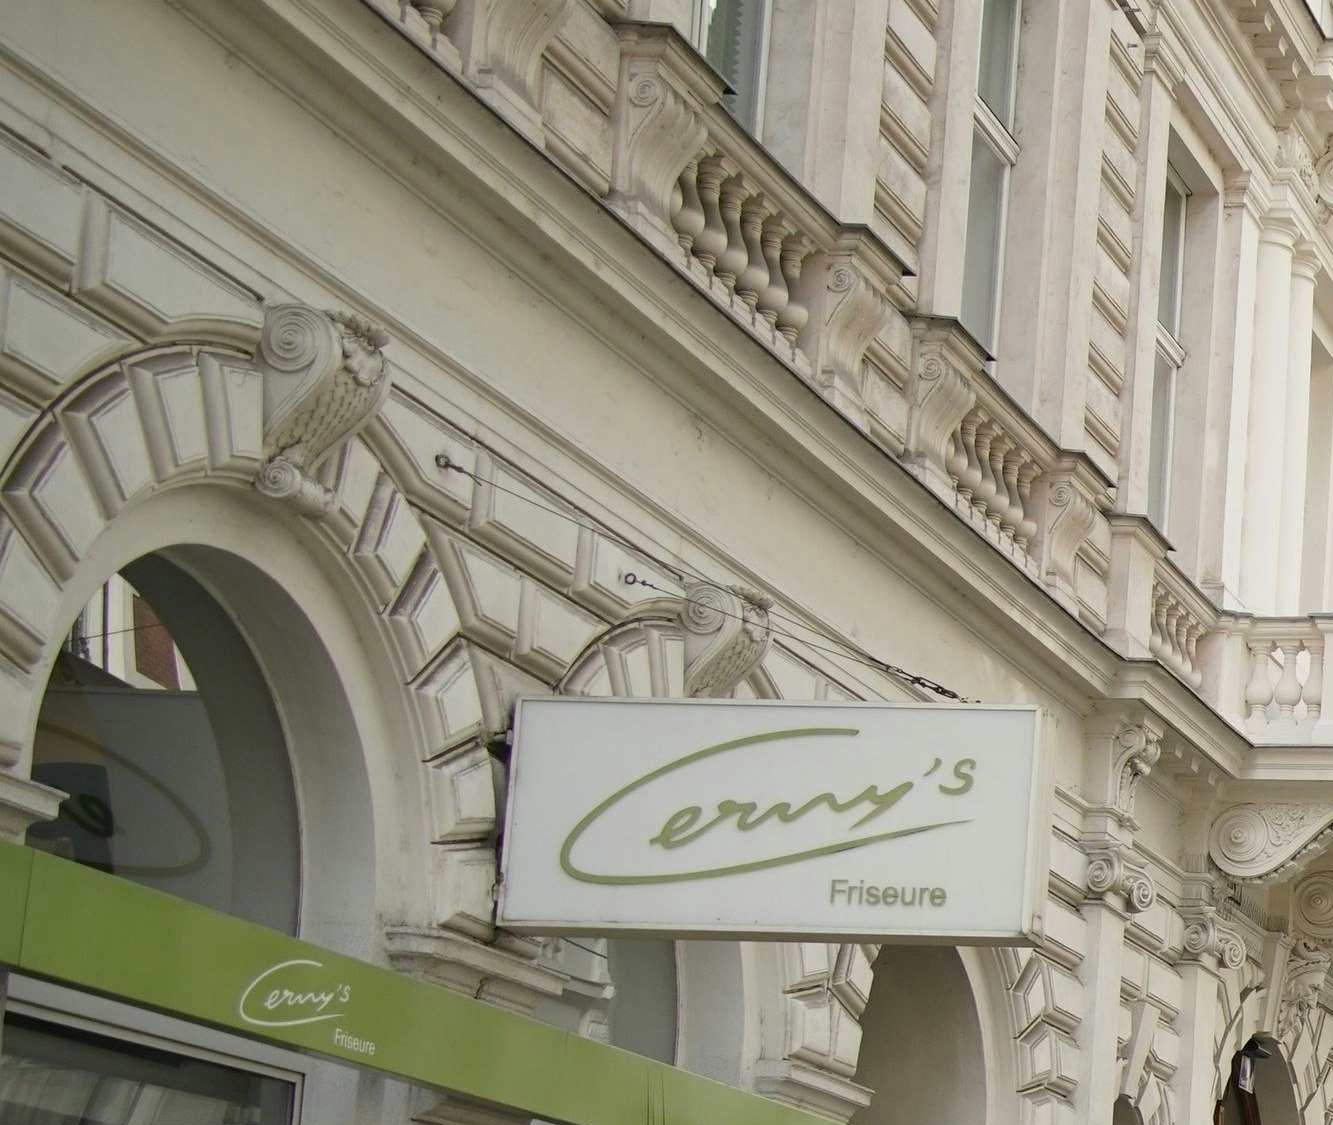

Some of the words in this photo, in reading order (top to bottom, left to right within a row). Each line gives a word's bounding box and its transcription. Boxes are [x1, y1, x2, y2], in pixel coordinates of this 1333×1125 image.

[560, 728, 976, 885] Cerny's
[829, 878, 948, 907] Friseure
[239, 959, 351, 1026] Cerny's
[333, 1027, 376, 1055] Friseure
